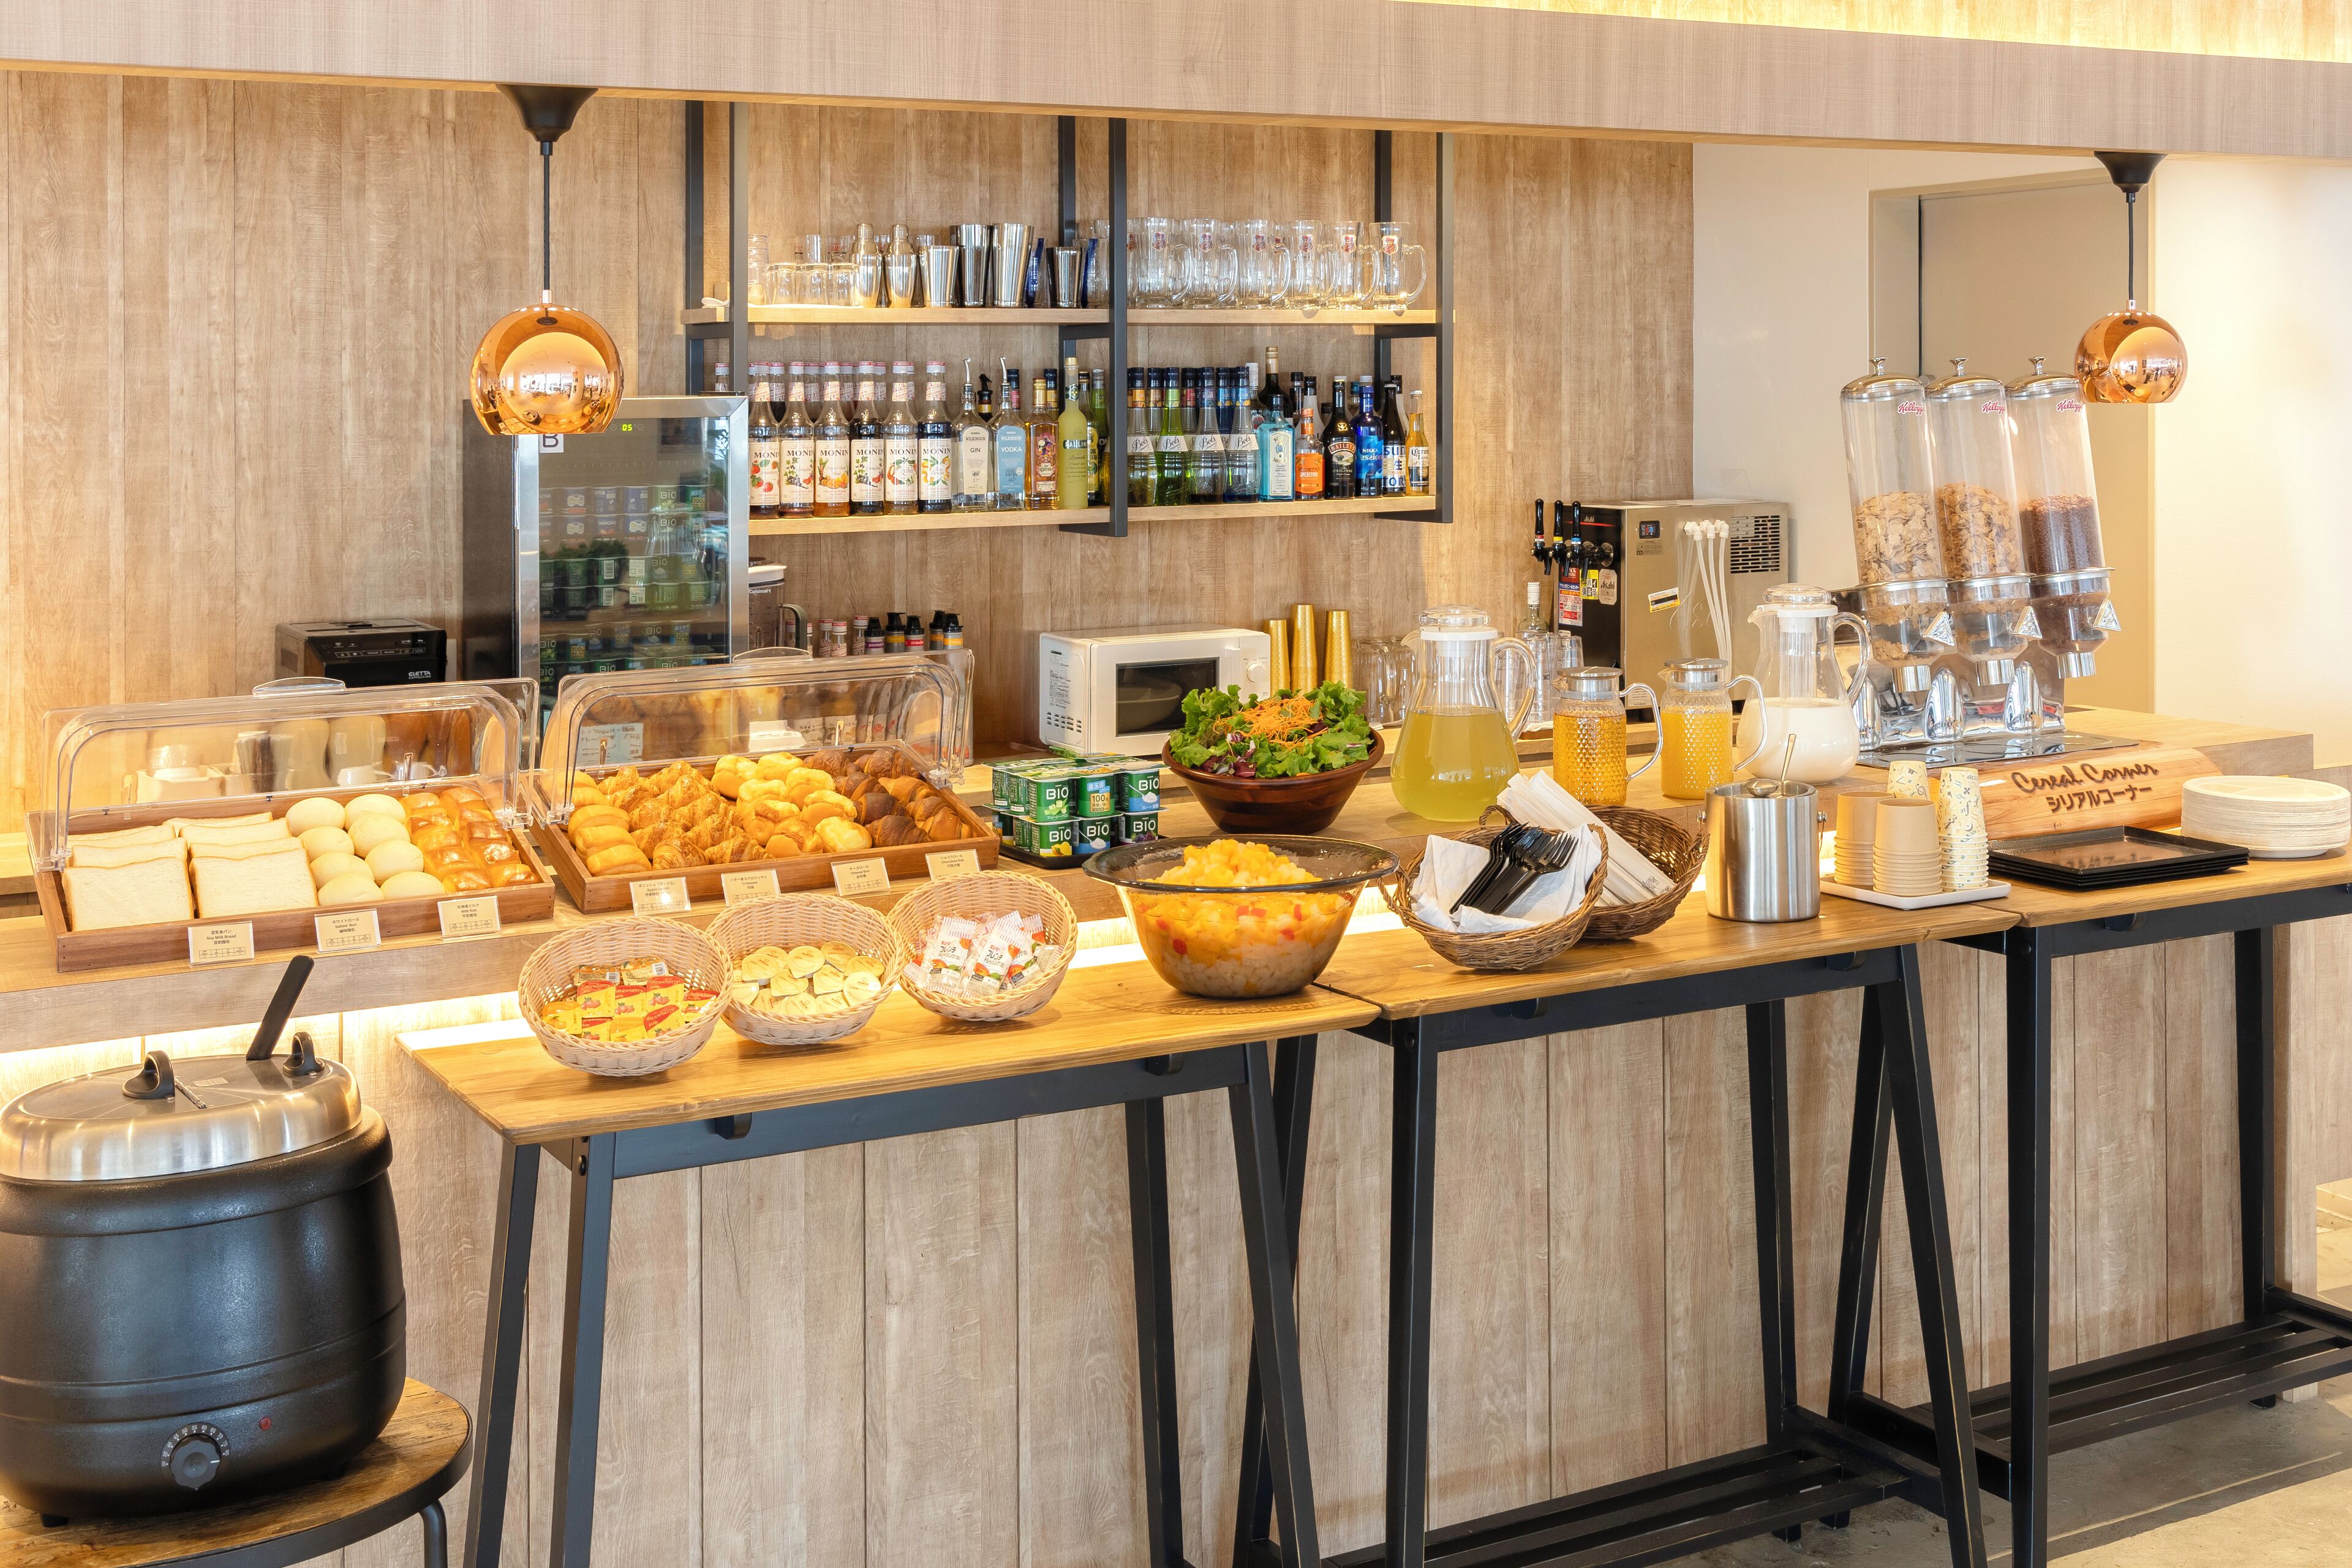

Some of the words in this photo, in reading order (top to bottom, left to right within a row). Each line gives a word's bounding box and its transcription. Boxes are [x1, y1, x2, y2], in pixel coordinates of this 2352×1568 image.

[1132, 437, 1148, 453] Bols
[1162, 435, 1180, 451] Bols
[1199, 434, 1216, 451] Bols
[1234, 434, 1251, 451] Bols
[1330, 442, 1355, 452] BAILEYS
[1601, 580, 1615, 589] Asahi
[1139, 778, 1159, 791] BIO
[2011, 766, 2083, 793] Cereal
[2081, 764, 2158, 783] Corner
[1046, 787, 1069, 800] BIO
[2046, 785, 2153, 813] シリアルコーナー
[1087, 824, 1109, 837] BIO
[1134, 820, 1156, 832] BIO
[1049, 829, 1071, 842] BIO
[986, 949, 1004, 960] フレンチ
[646, 1007, 674, 1022] Strawberry
